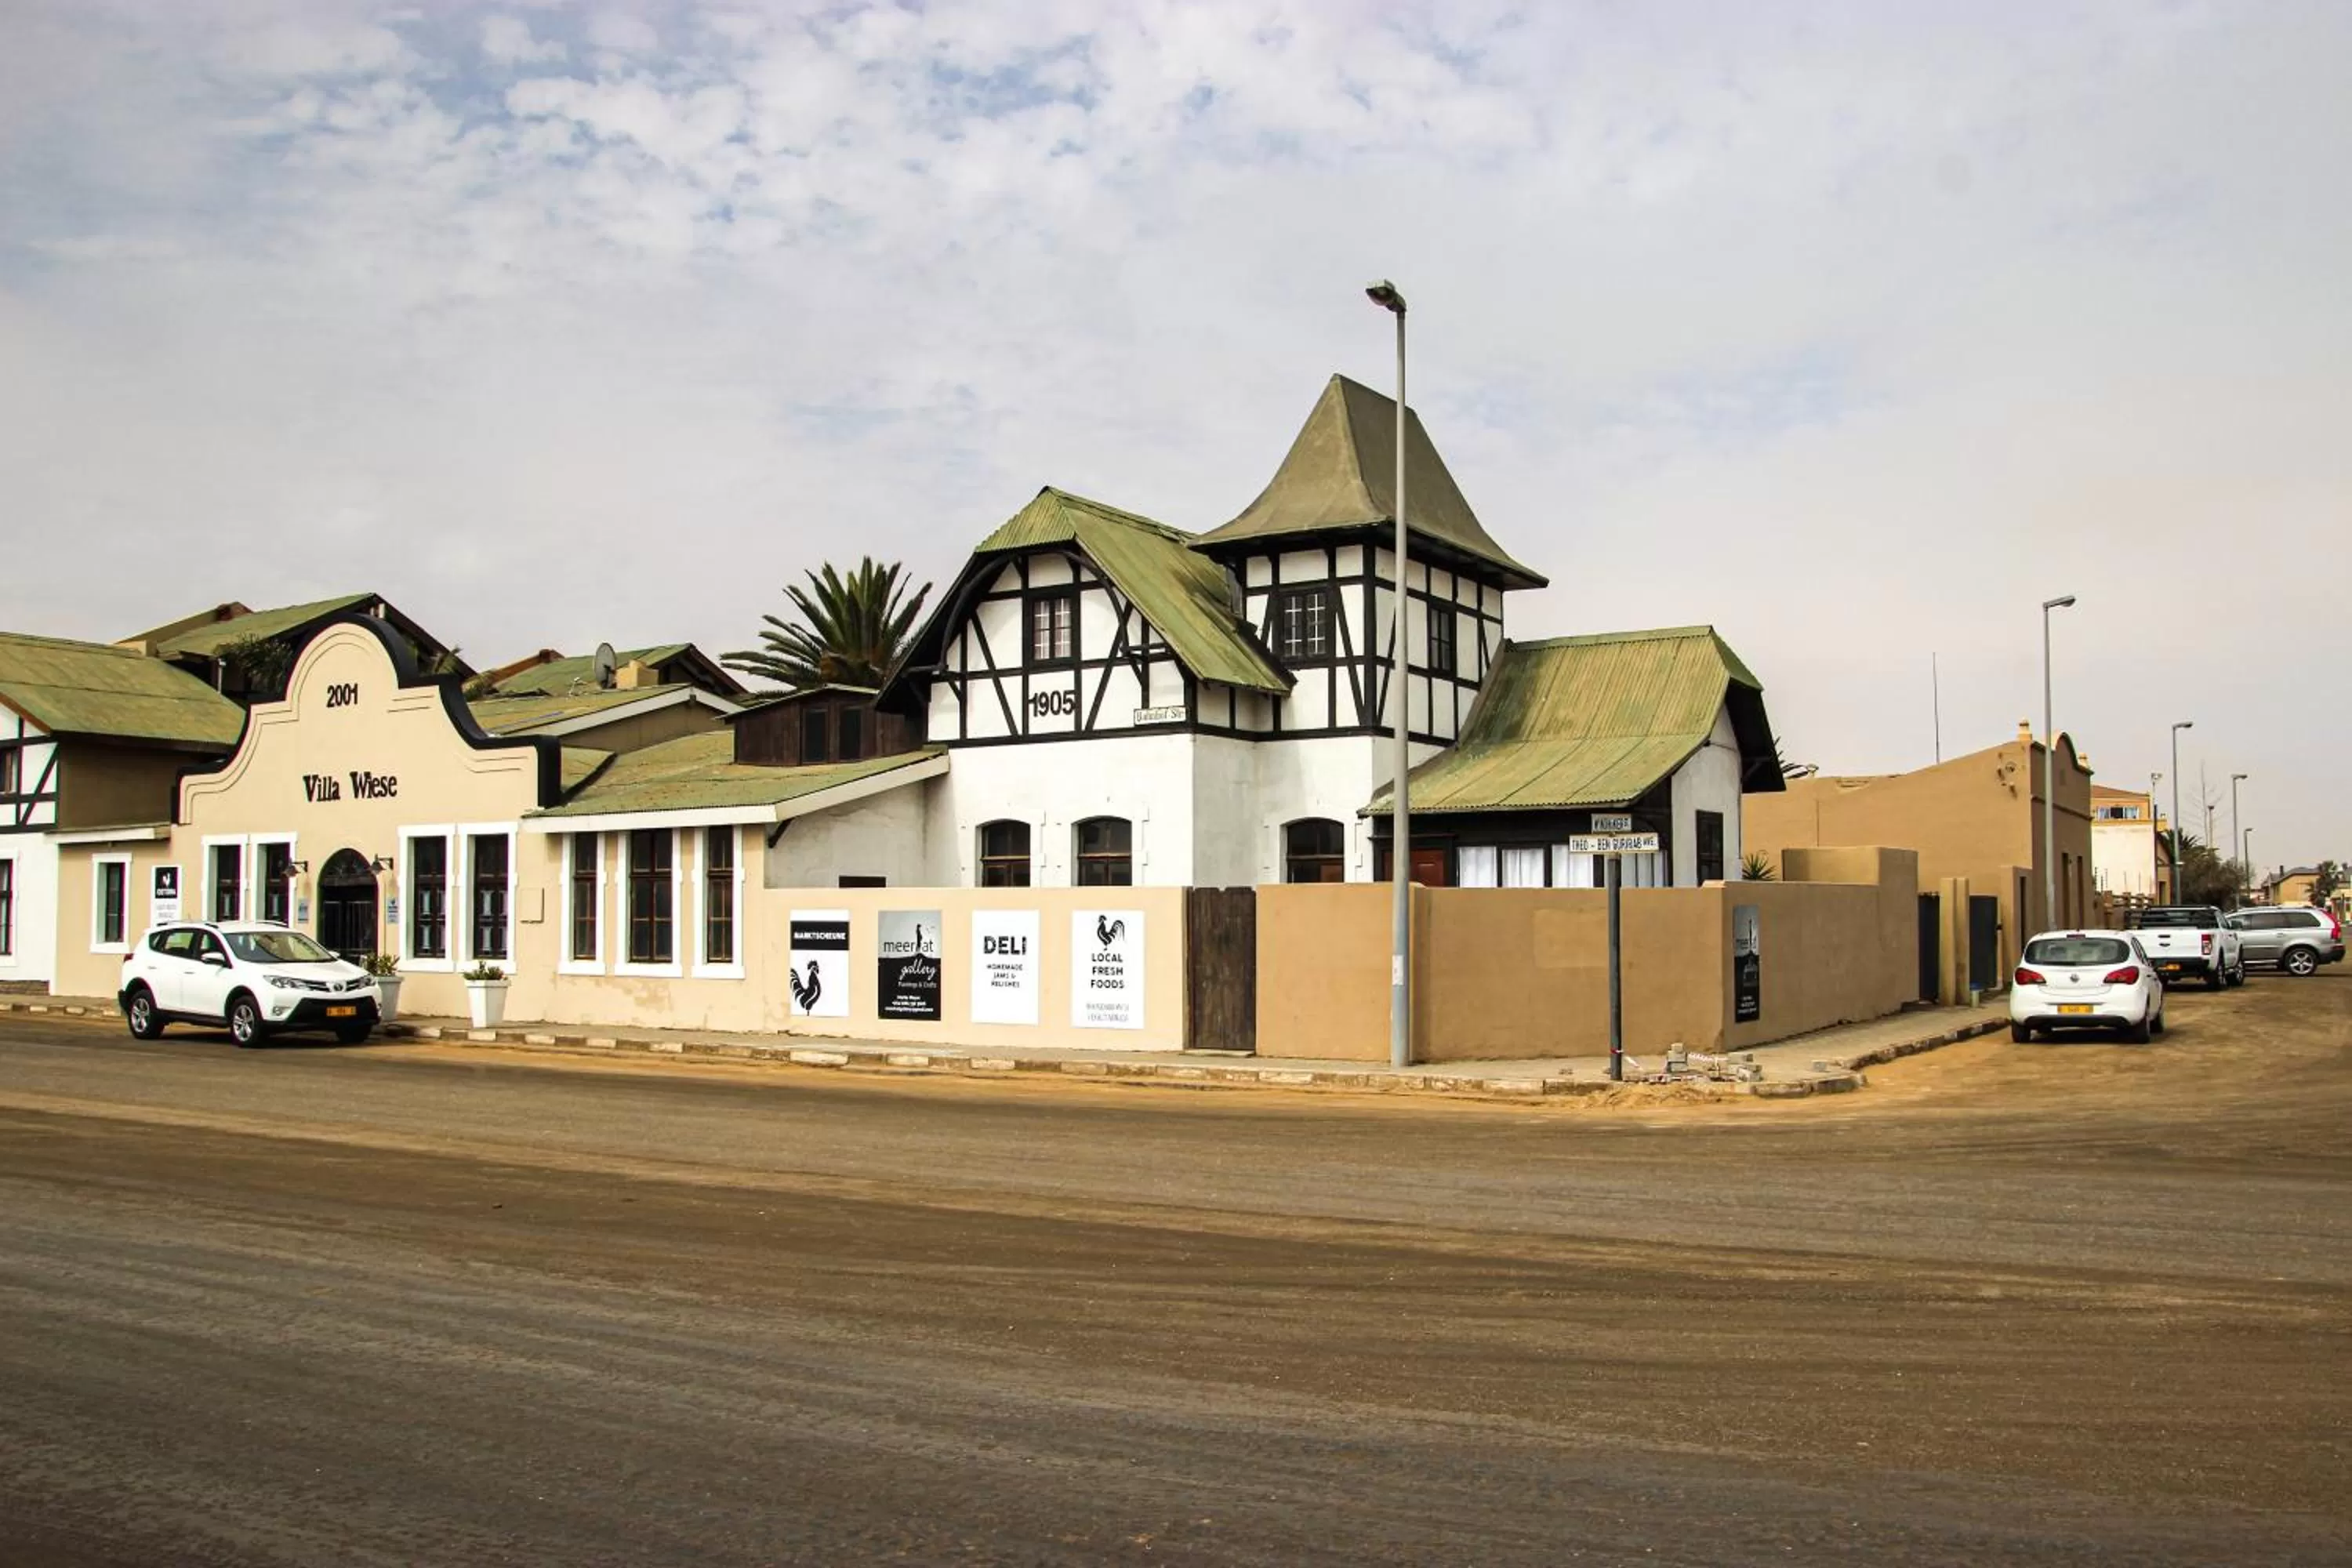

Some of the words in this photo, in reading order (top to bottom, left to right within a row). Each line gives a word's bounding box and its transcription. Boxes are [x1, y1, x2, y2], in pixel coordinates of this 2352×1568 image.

[326, 683, 358, 708] 2001
[1029, 690, 1076, 717] 1905
[303, 774, 341, 802] Villa
[350, 771, 397, 799] Wiese
[983, 935, 1027, 956] DELI
[1091, 953, 1124, 963] LOCAL
[899, 958, 936, 981] gallery
[1091, 966, 1123, 976] FRESH
[1090, 979, 1125, 989] FOODS
